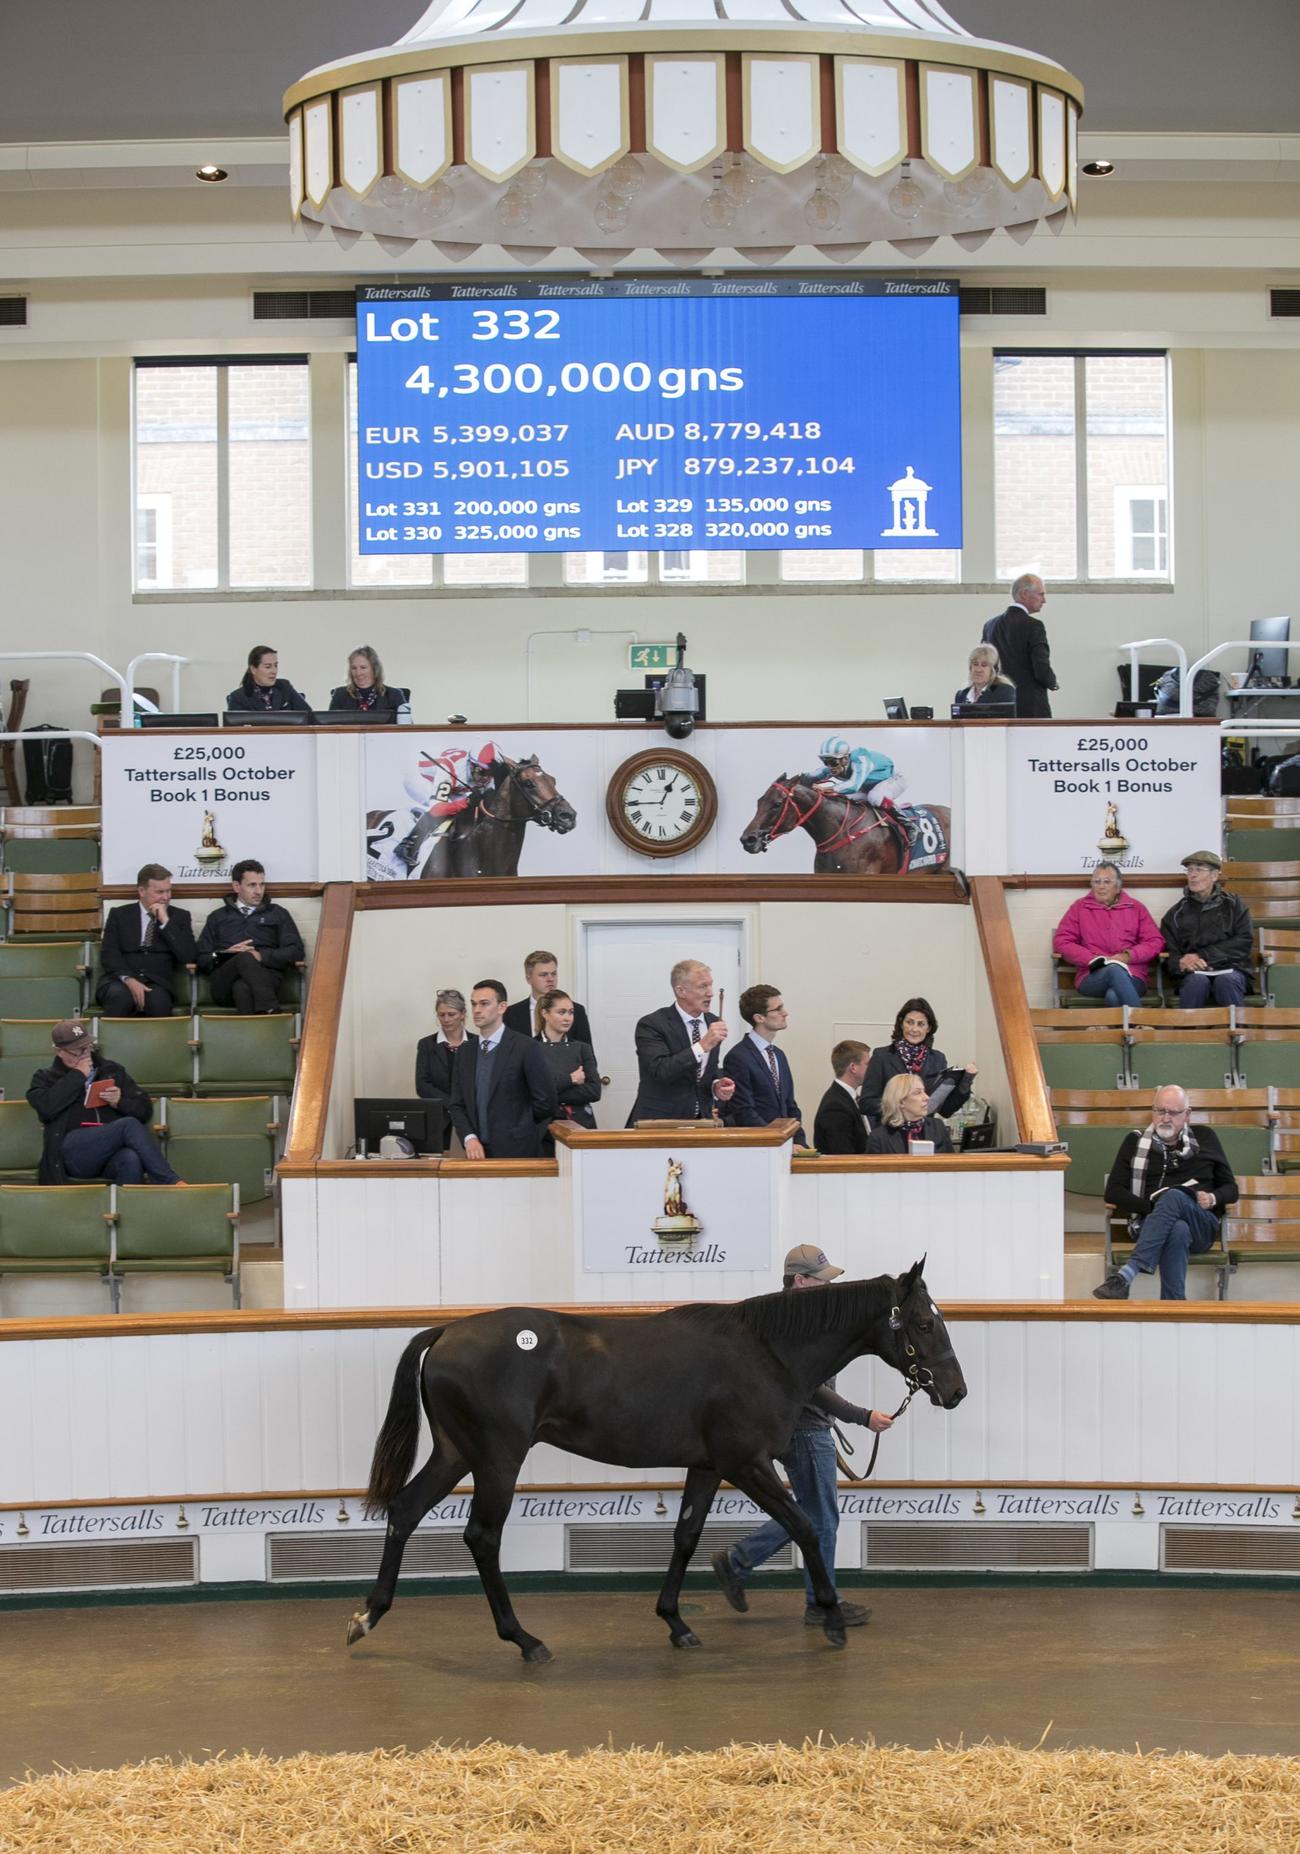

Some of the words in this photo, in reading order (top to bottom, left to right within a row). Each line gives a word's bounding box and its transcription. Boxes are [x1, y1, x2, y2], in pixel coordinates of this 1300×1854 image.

[365, 286, 431, 299] Tattersalls
[451, 284, 517, 298] Tattersalls
[538, 283, 604, 296] Tattersalls
[625, 282, 691, 295] Tattersalls
[711, 282, 777, 294] Tattersalls
[798, 281, 863, 294] Tattersalls
[885, 281, 950, 294] Tattersalls
[366, 312, 440, 342] Lot
[472, 309, 561, 341] 332
[405, 361, 652, 399] 4,300,000
[658, 367, 744, 399] gns
[366, 426, 421, 444] EUR
[433, 424, 569, 445] 5,399,037
[615, 423, 675, 441] AUD
[684, 422, 821, 442] 8,779,418
[366, 461, 423, 479] USD
[433, 459, 570, 481] 5,901,105
[615, 458, 658, 480] JPY
[684, 456, 856, 477] 879,237,104
[365, 502, 398, 517] Lot
[402, 501, 441, 516] 331
[454, 500, 538, 516] 200,000
[543, 502, 581, 517] gns
[616, 499, 649, 513] Lot
[654, 498, 693, 513] 329
[705, 497, 789, 514] 135,000
[794, 500, 832, 515] gns
[366, 527, 398, 541] Lot
[403, 526, 442, 541] 330
[454, 524, 539, 541] 325,000
[543, 527, 581, 542] gns
[616, 524, 650, 538] Lot
[654, 523, 693, 538] 328
[705, 522, 789, 538] 320,000
[794, 524, 832, 539] gns
[173, 746, 246, 762] £25,000
[1077, 738, 1149, 753] £25,000
[124, 766, 217, 782] Tattersalls
[222, 765, 296, 781] October
[1027, 758, 1120, 773] Tattersalls
[1125, 757, 1198, 772] October
[436, 782, 452, 802] 2
[1054, 779, 1100, 793] Book
[1105, 780, 1111, 793] 1
[1117, 779, 1173, 793] Bonus
[150, 788, 197, 803] Book
[201, 789, 208, 802] 1
[214, 788, 271, 802] Bonus
[920, 817, 938, 854] 8
[624, 1243, 728, 1265] Tattersalls
[521, 1337, 533, 1345] 332
[39, 1507, 164, 1535] Tattersalls
[199, 1499, 325, 1527] Tattersalls
[519, 1494, 643, 1517] Tattersalls
[837, 1493, 962, 1514] Tattersalls
[997, 1494, 1118, 1515] Tattersalls
[1157, 1496, 1280, 1518] Tattersalls
